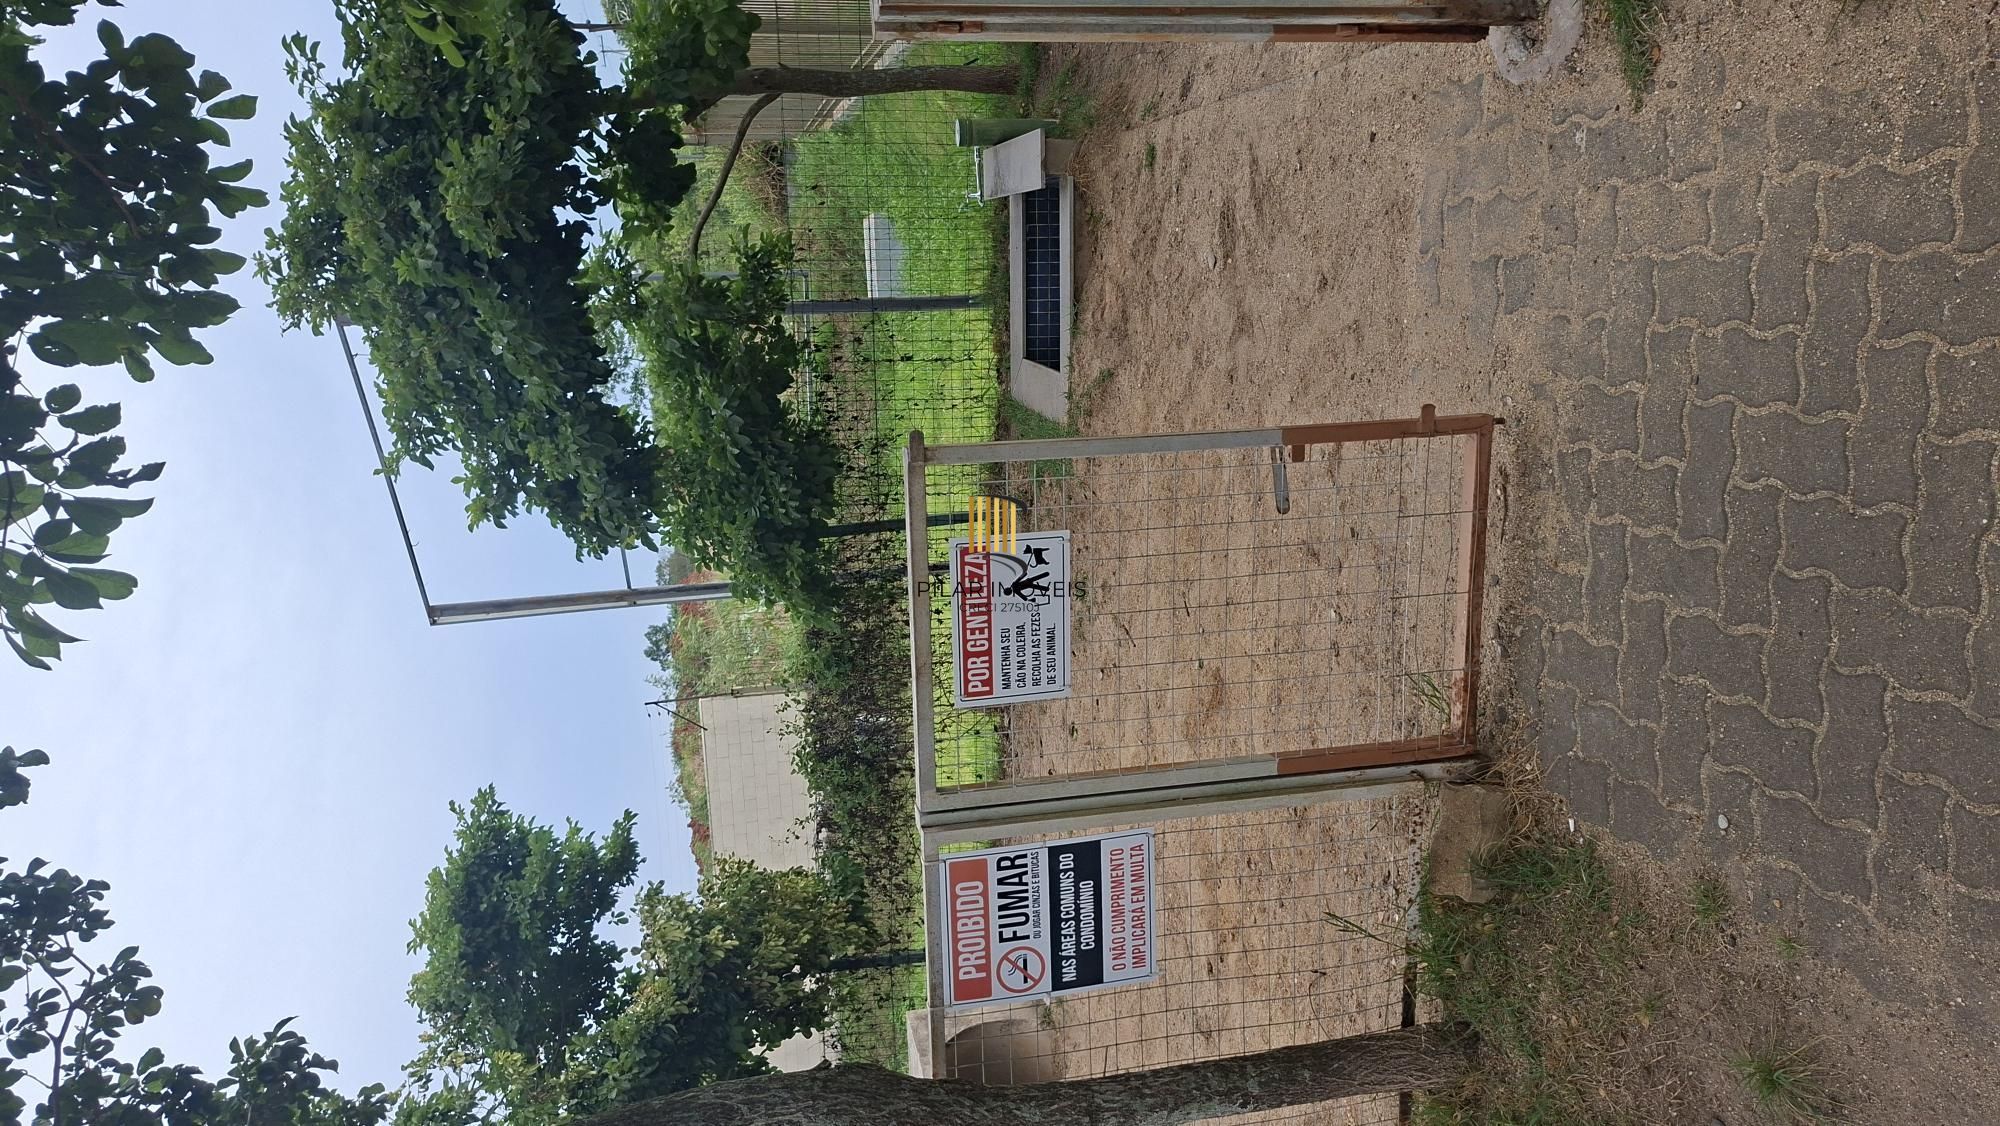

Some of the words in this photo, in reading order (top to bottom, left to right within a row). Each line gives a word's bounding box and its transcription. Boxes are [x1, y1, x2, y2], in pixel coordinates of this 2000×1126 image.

[964, 552, 989, 652] GENTILEZA
[1000, 627, 1011, 643] SEU
[1030, 612, 1041, 636] FEZES
[1032, 637, 1041, 650] AS
[1046, 622, 1056, 655] ANIMAL.
[967, 656, 990, 693] POR
[1001, 644, 1012, 690] MANTENHA
[1016, 658, 1026, 669] NA
[1032, 650, 1042, 687] RECOLHA
[1046, 656, 1056, 673] SEU
[1015, 671, 1027, 689] CÃO
[1046, 674, 1057, 685] DE
[1031, 851, 1040, 877] BITUCAS
[1059, 852, 1075, 867] DO
[1130, 843, 1145, 883] MULTA
[996, 853, 1031, 944] FUMAR
[1032, 884, 1041, 907] CINZAS
[1060, 869, 1076, 917] COMUNS
[1110, 847, 1126, 934] CUMPRIMENTO
[1132, 885, 1146, 905] EM
[1033, 908, 1042, 928] JOGAR
[1077, 880, 1096, 950] CONDOMÍNIO
[955, 880, 987, 981] PROIBIDO
[1033, 929, 1042, 939] OU
[1058, 917, 1077, 956] ÁREAS
[1128, 905, 1147, 969] IMPLICARÁ
[1109, 941, 1127, 961] NÃO
[1062, 957, 1077, 982] NAS
[1112, 963, 1127, 971] O
